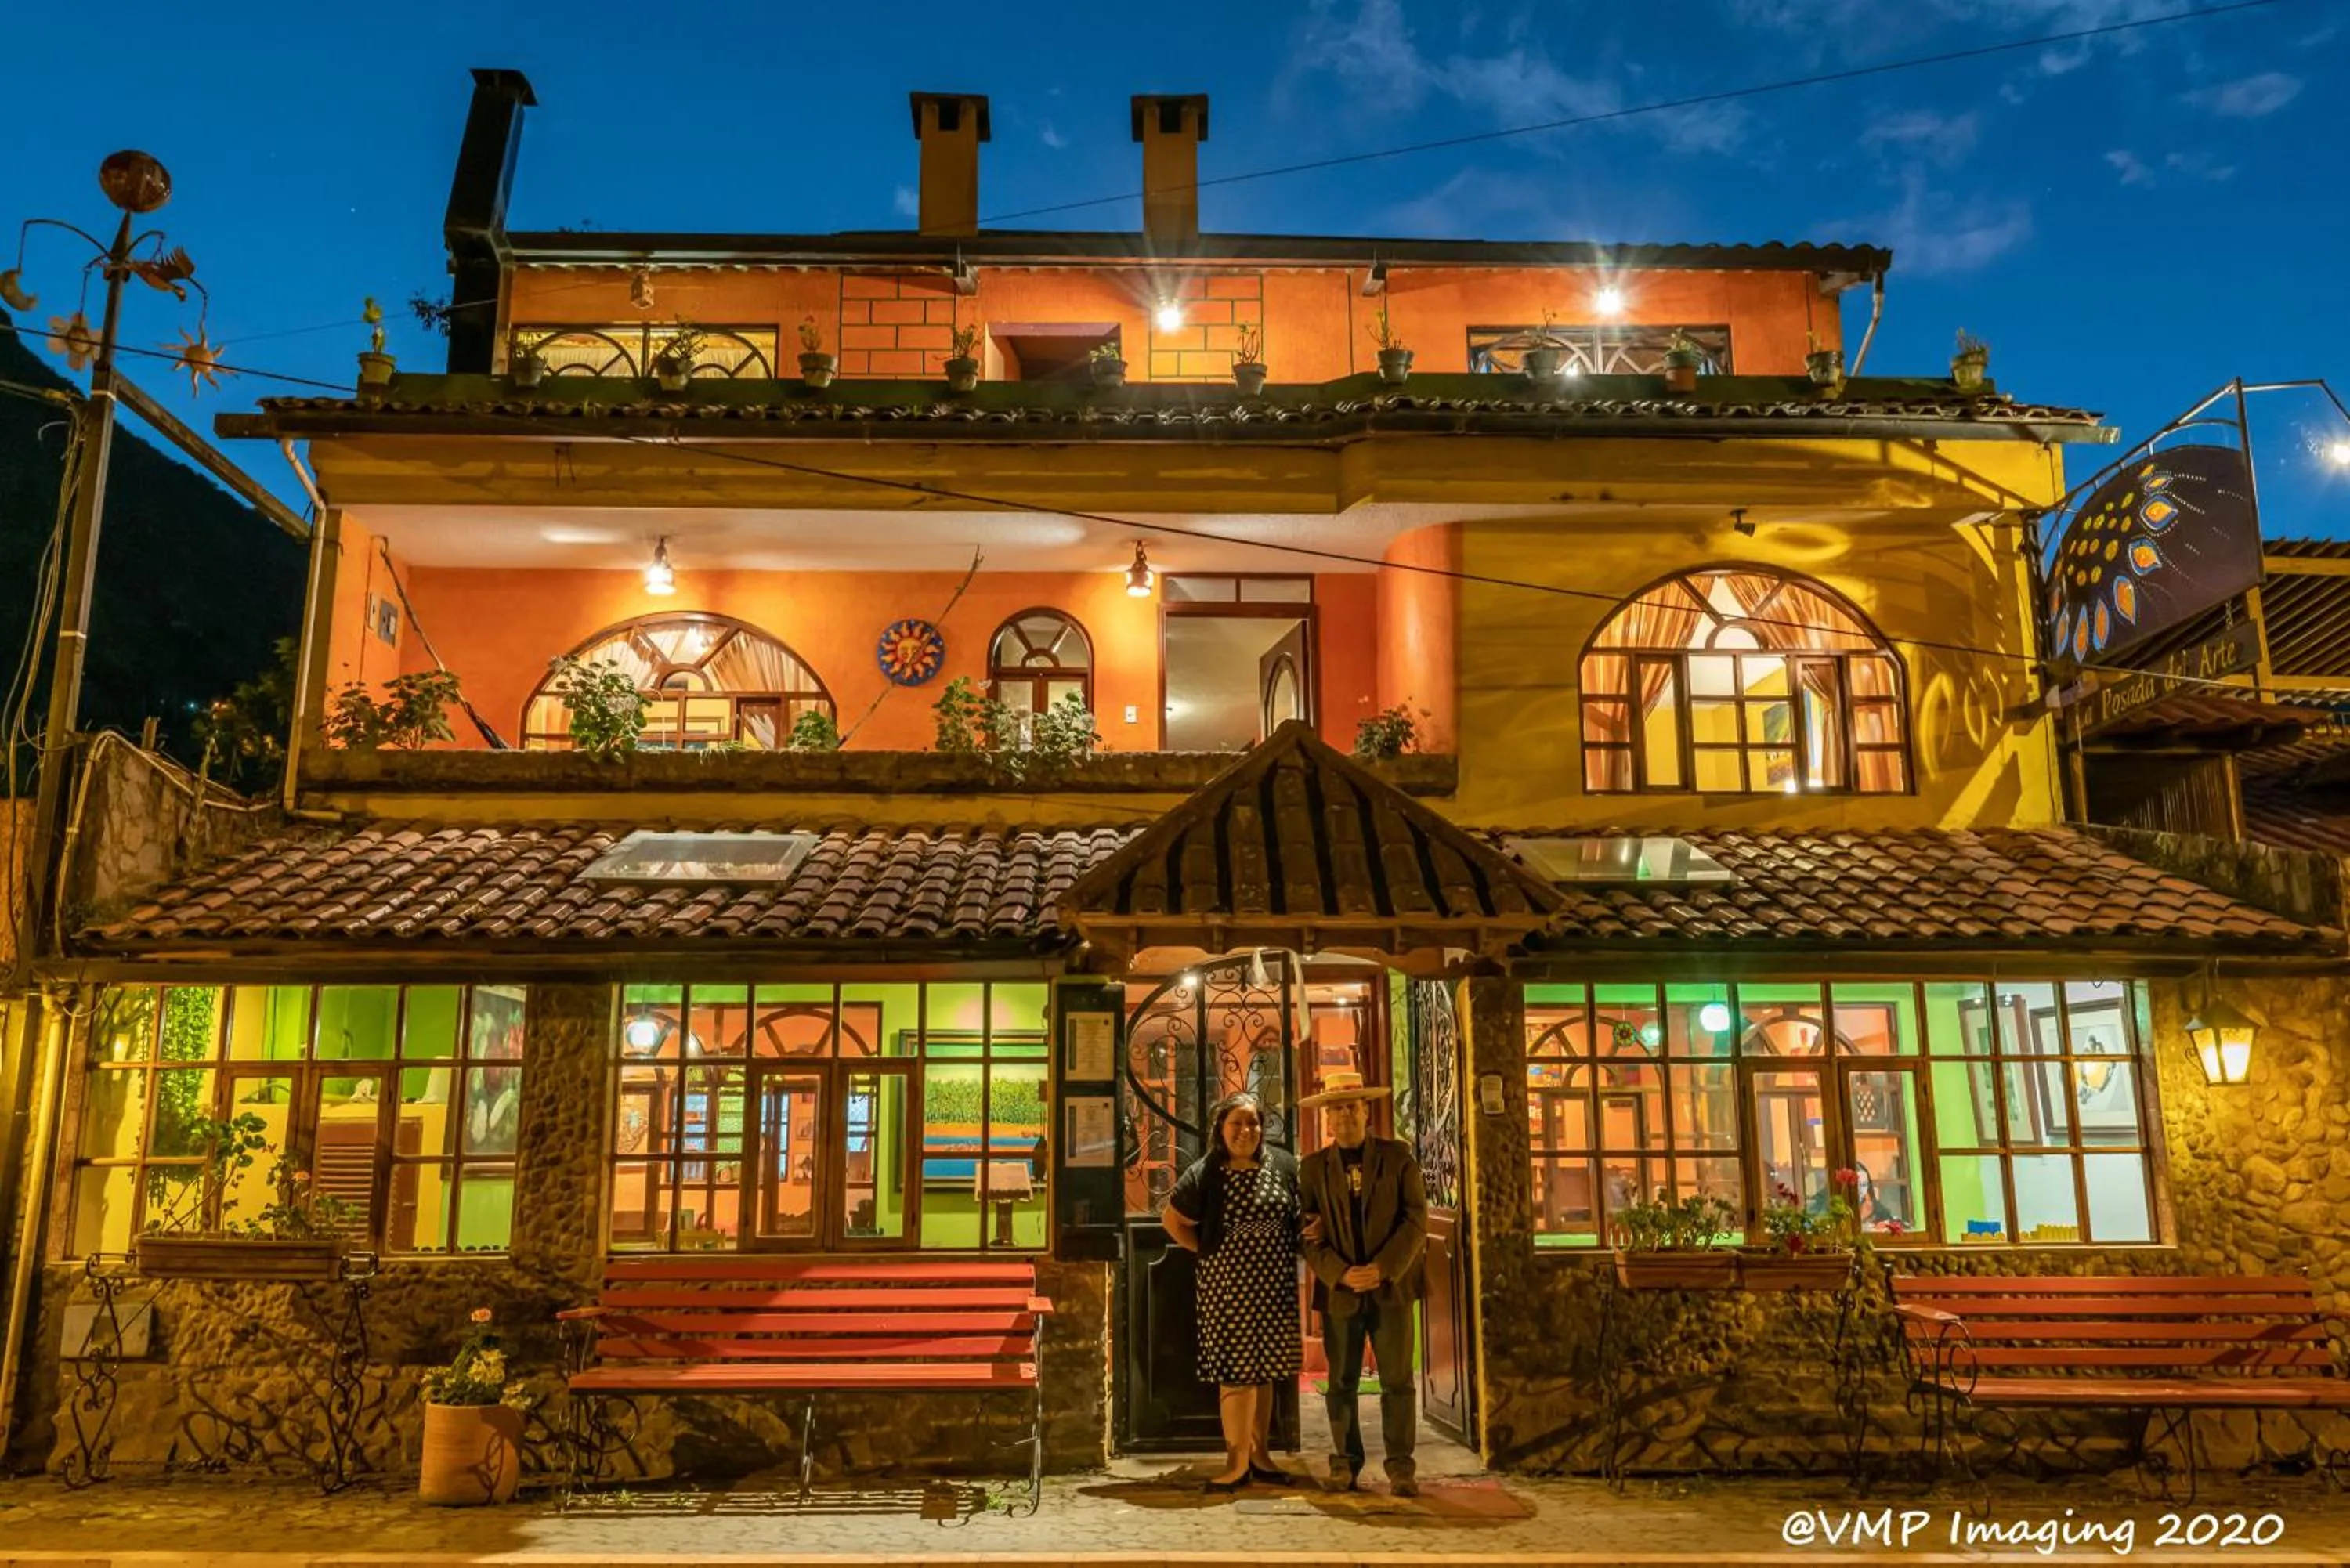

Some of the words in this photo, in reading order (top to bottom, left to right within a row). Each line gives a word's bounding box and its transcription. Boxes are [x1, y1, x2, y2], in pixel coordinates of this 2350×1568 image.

[2102, 672, 2155, 720] Posada
[2164, 649, 2187, 692] del
[2199, 639, 2235, 678] Arte
